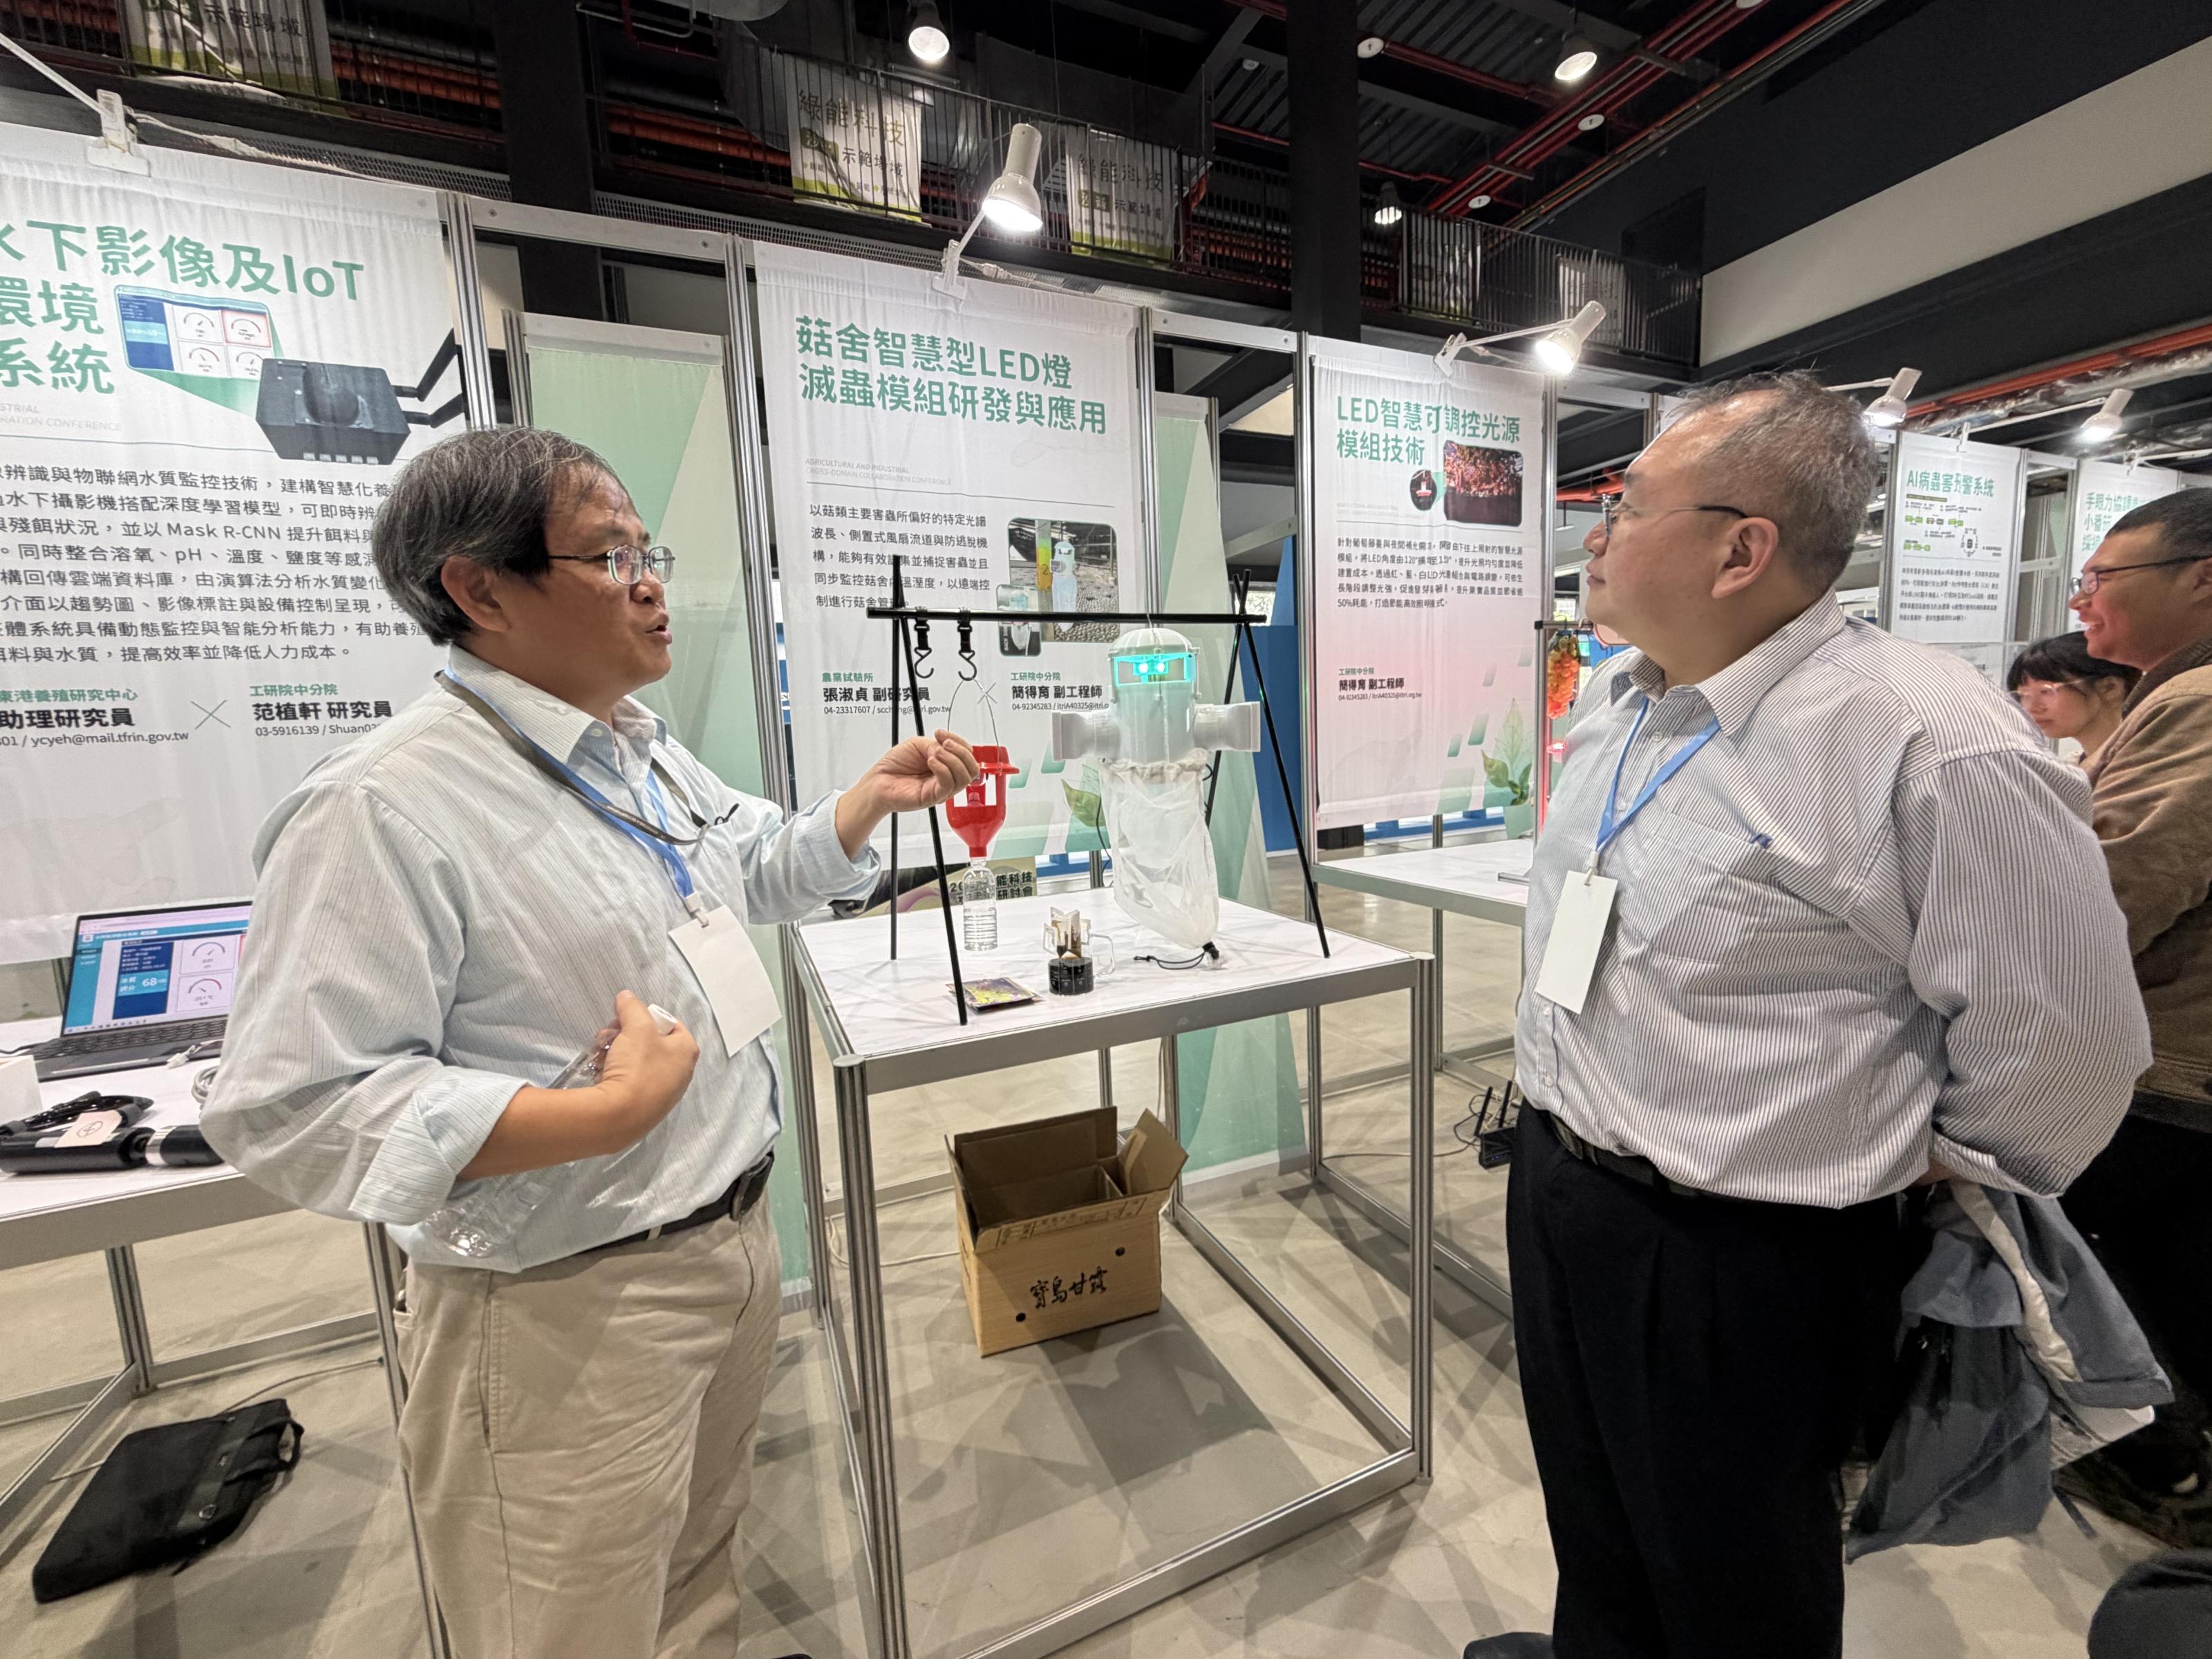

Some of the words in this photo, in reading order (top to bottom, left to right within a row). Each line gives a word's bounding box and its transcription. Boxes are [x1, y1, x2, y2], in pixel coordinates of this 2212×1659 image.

[0, 276, 104, 335] 環境
[795, 315, 1072, 390] 菇舍智慧型LED燈
[0, 337, 115, 395] 系統
[798, 363, 1106, 435] 滅蟲模組研發與應用
[1337, 396, 1521, 444] LED智慧可調控光源
[1337, 428, 1425, 466] 模組技術
[167, 522, 218, 538] Mask
[223, 525, 281, 540] R-CNN
[822, 672, 874, 682] 農業試驗所
[1011, 672, 1061, 682] 工研院中分院
[1369, 677, 1405, 690] 副工程師
[250, 683, 339, 697] 工研院中分院
[823, 687, 868, 702] 張淑貞
[1012, 685, 1049, 700] 簡得育
[1053, 685, 1103, 699] 副工程師
[252, 702, 321, 721] 范植軒
[326, 700, 393, 720] 研究員
[824, 706, 870, 714] 04-23317607
[1012, 702, 1051, 711] 04-92345283
[0, 708, 135, 729] 助理研究員
[255, 725, 319, 737] 03-5916139
[30, 731, 189, 748] ycyeh@mail.tfrin.gov.tw
[142, 977, 158, 987] 68
